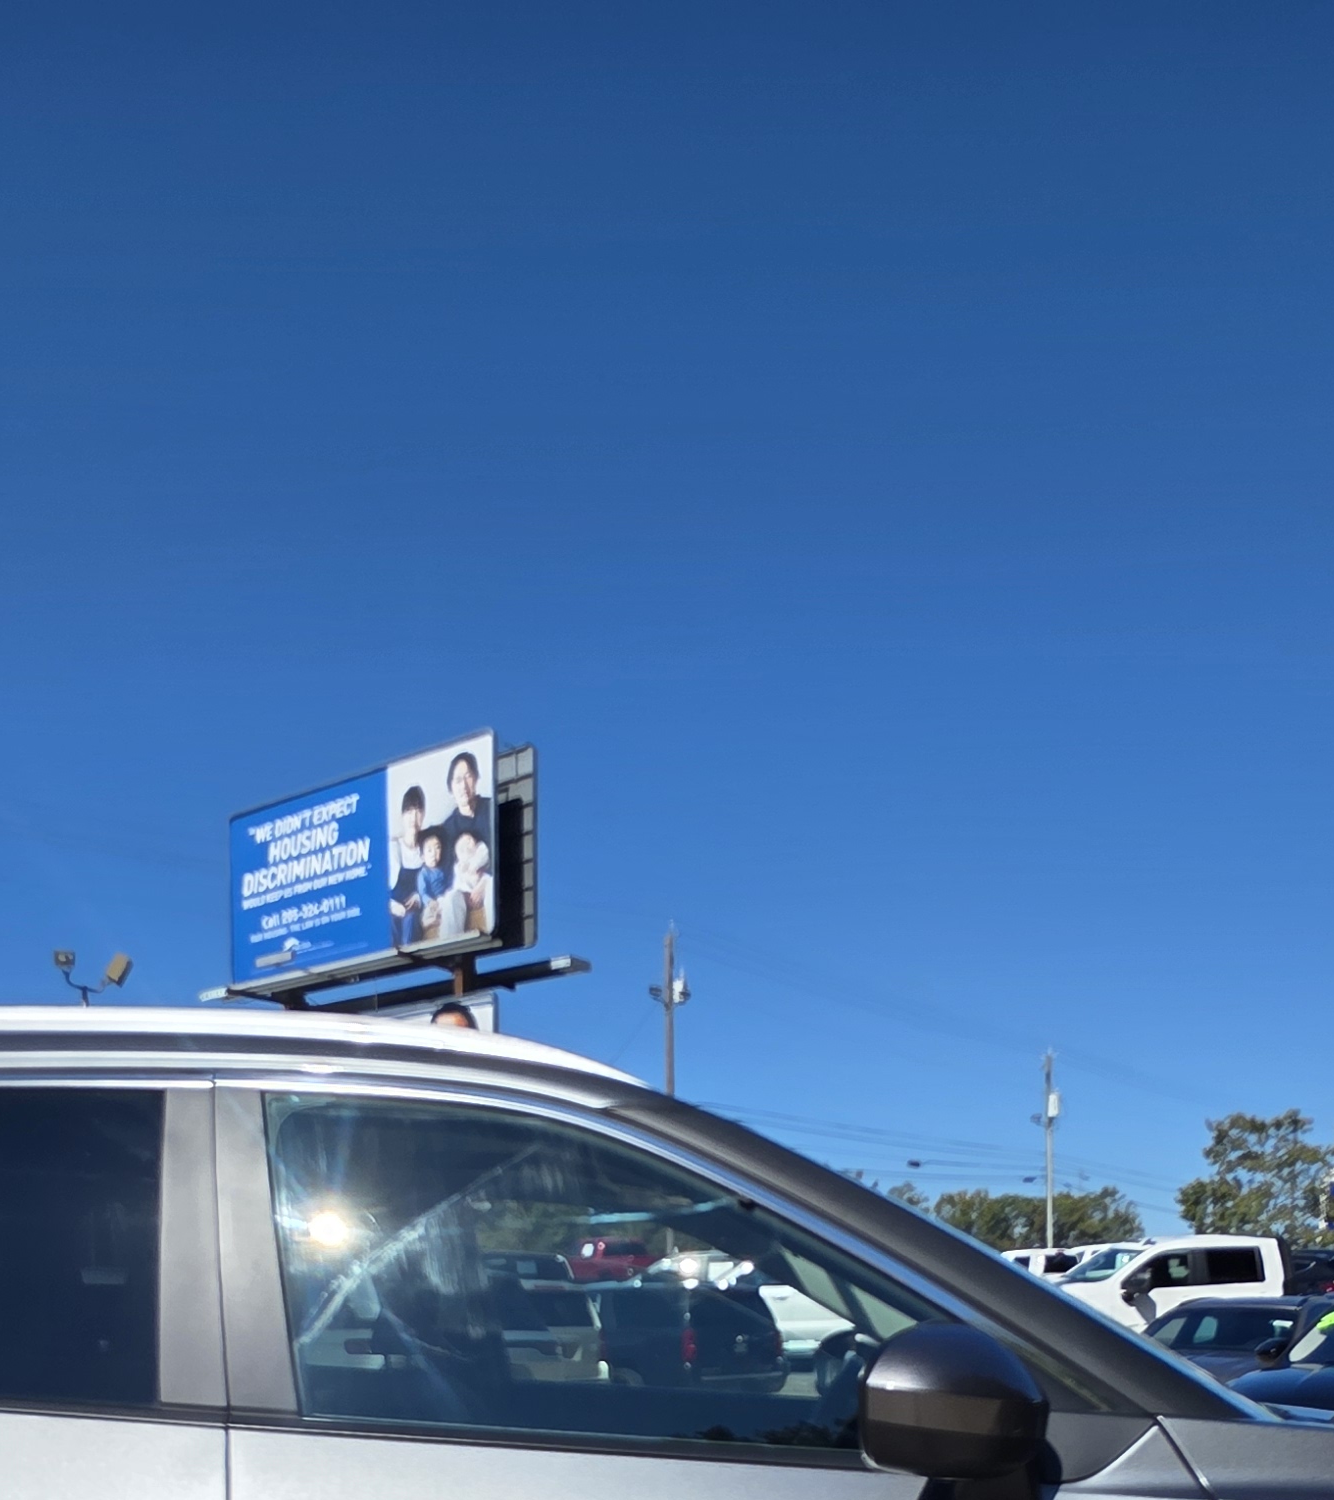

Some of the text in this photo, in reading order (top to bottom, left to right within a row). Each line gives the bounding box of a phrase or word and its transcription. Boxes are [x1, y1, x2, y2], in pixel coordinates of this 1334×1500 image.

[274, 808, 312, 837] DIDN'T
[312, 793, 360, 825] EXPECT
[268, 821, 339, 864] HOUSING
[242, 835, 371, 898] DISCRIMINATION
[261, 912, 280, 930] Call
